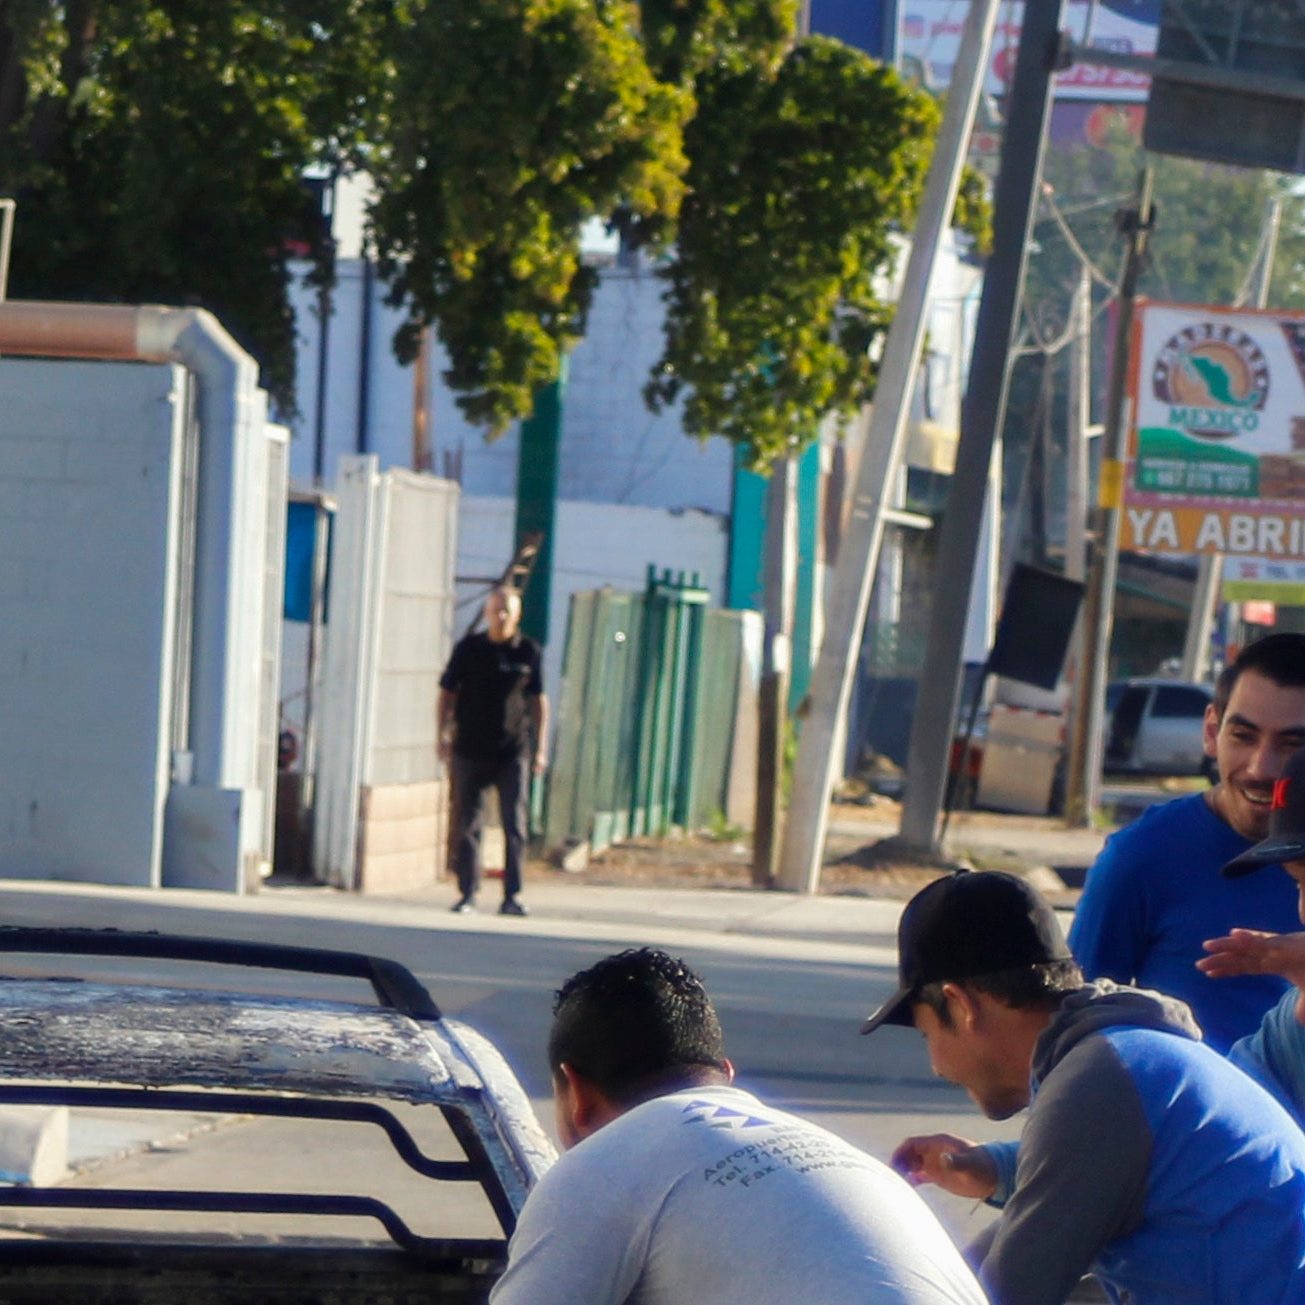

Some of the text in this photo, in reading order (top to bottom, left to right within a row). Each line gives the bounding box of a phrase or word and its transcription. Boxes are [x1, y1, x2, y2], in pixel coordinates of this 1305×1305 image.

[1168, 407, 1259, 431] MEXICO
[1128, 509, 1179, 547] YA
[703, 1131, 800, 1182] Aeropuerto
